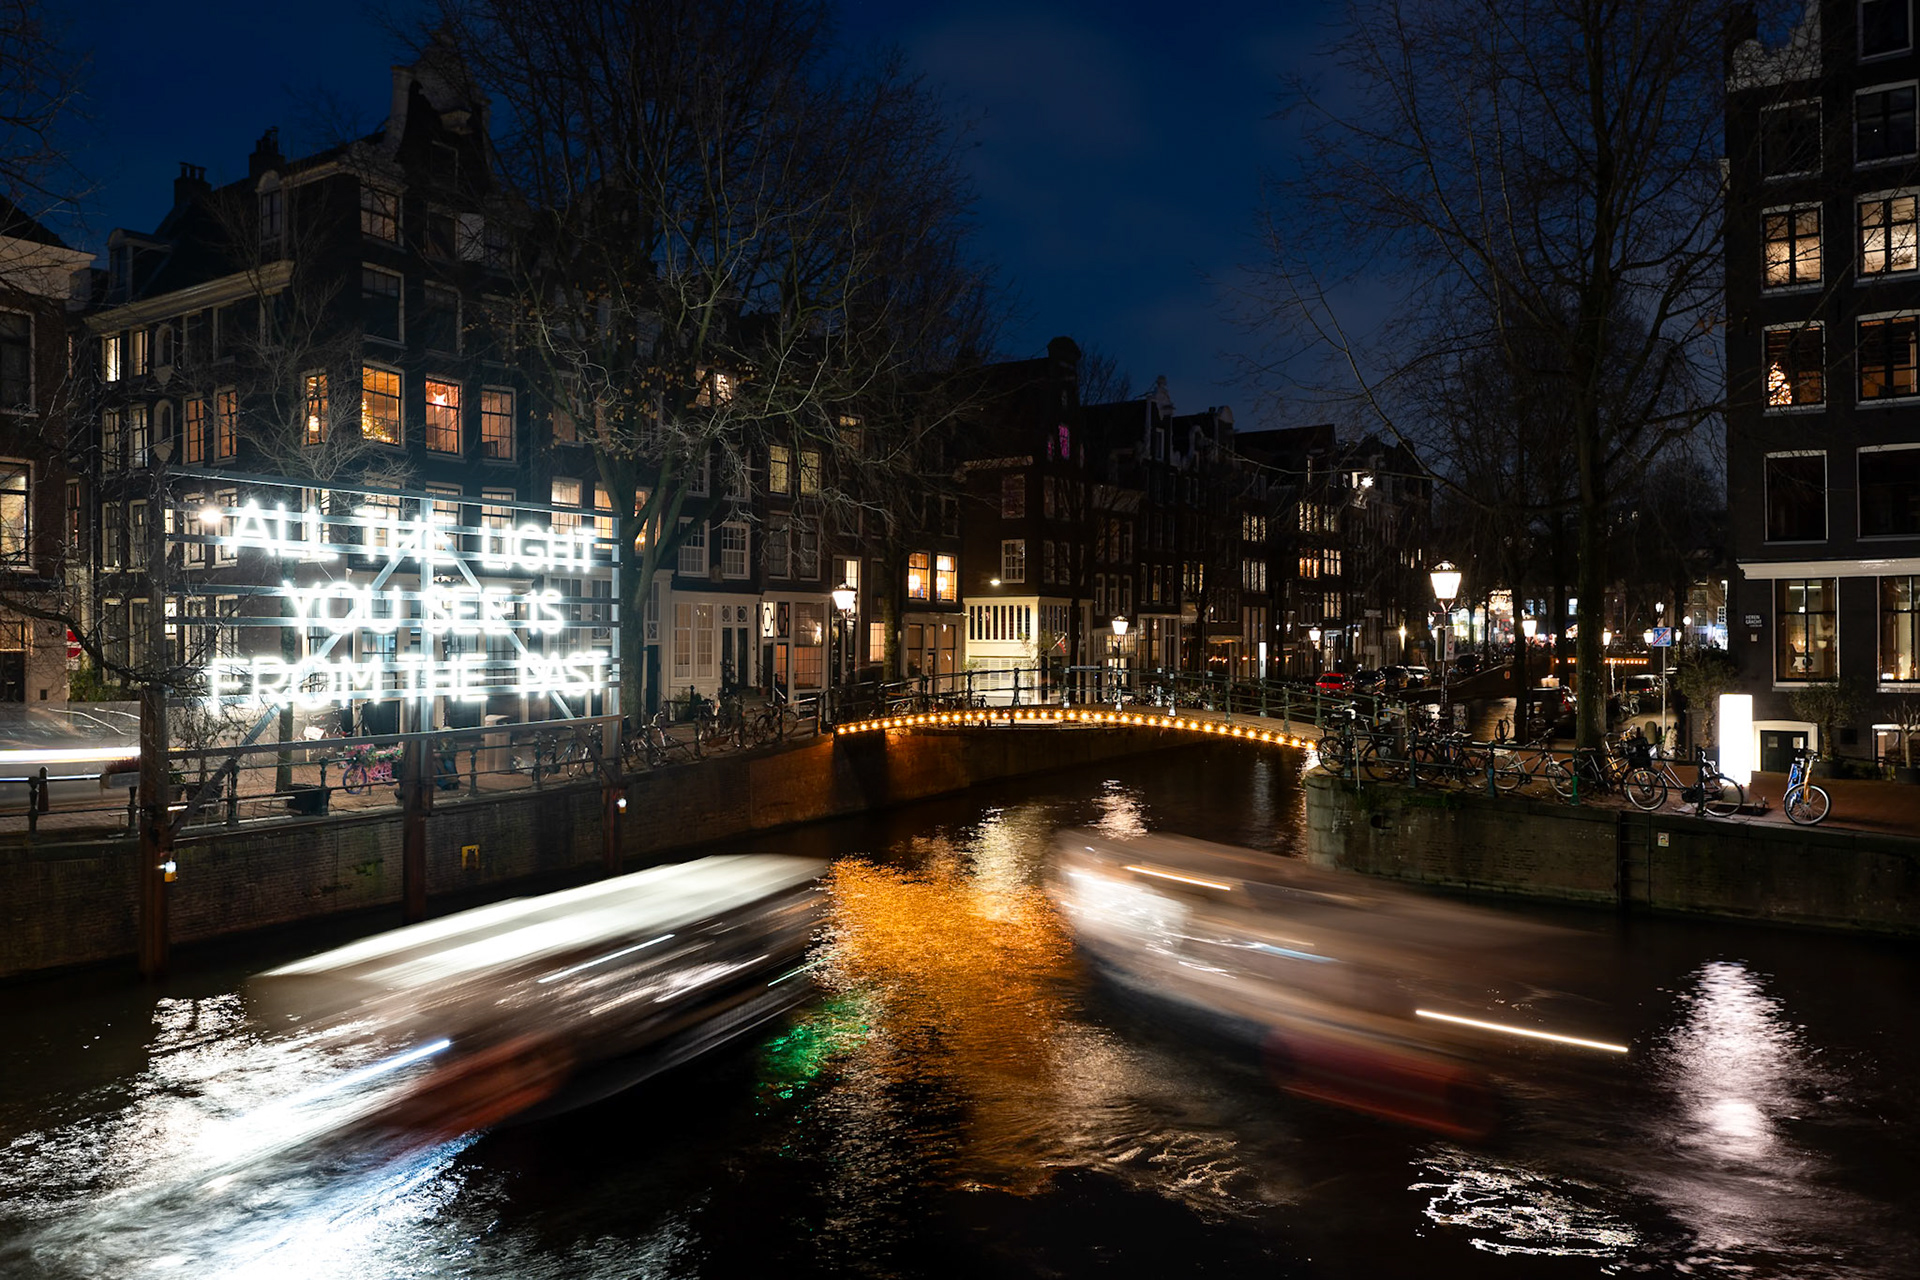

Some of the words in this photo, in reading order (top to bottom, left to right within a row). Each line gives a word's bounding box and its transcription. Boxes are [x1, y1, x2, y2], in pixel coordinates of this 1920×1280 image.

[229, 498, 338, 560] ALL
[354, 508, 457, 565] THE
[479, 523, 597, 573] LIGHT
[283, 580, 403, 634] YOU
[422, 585, 512, 635] SEE
[528, 588, 565, 634] IS
[211, 654, 383, 716] FROM
[396, 653, 489, 705] THE
[519, 650, 609, 699] PAST
